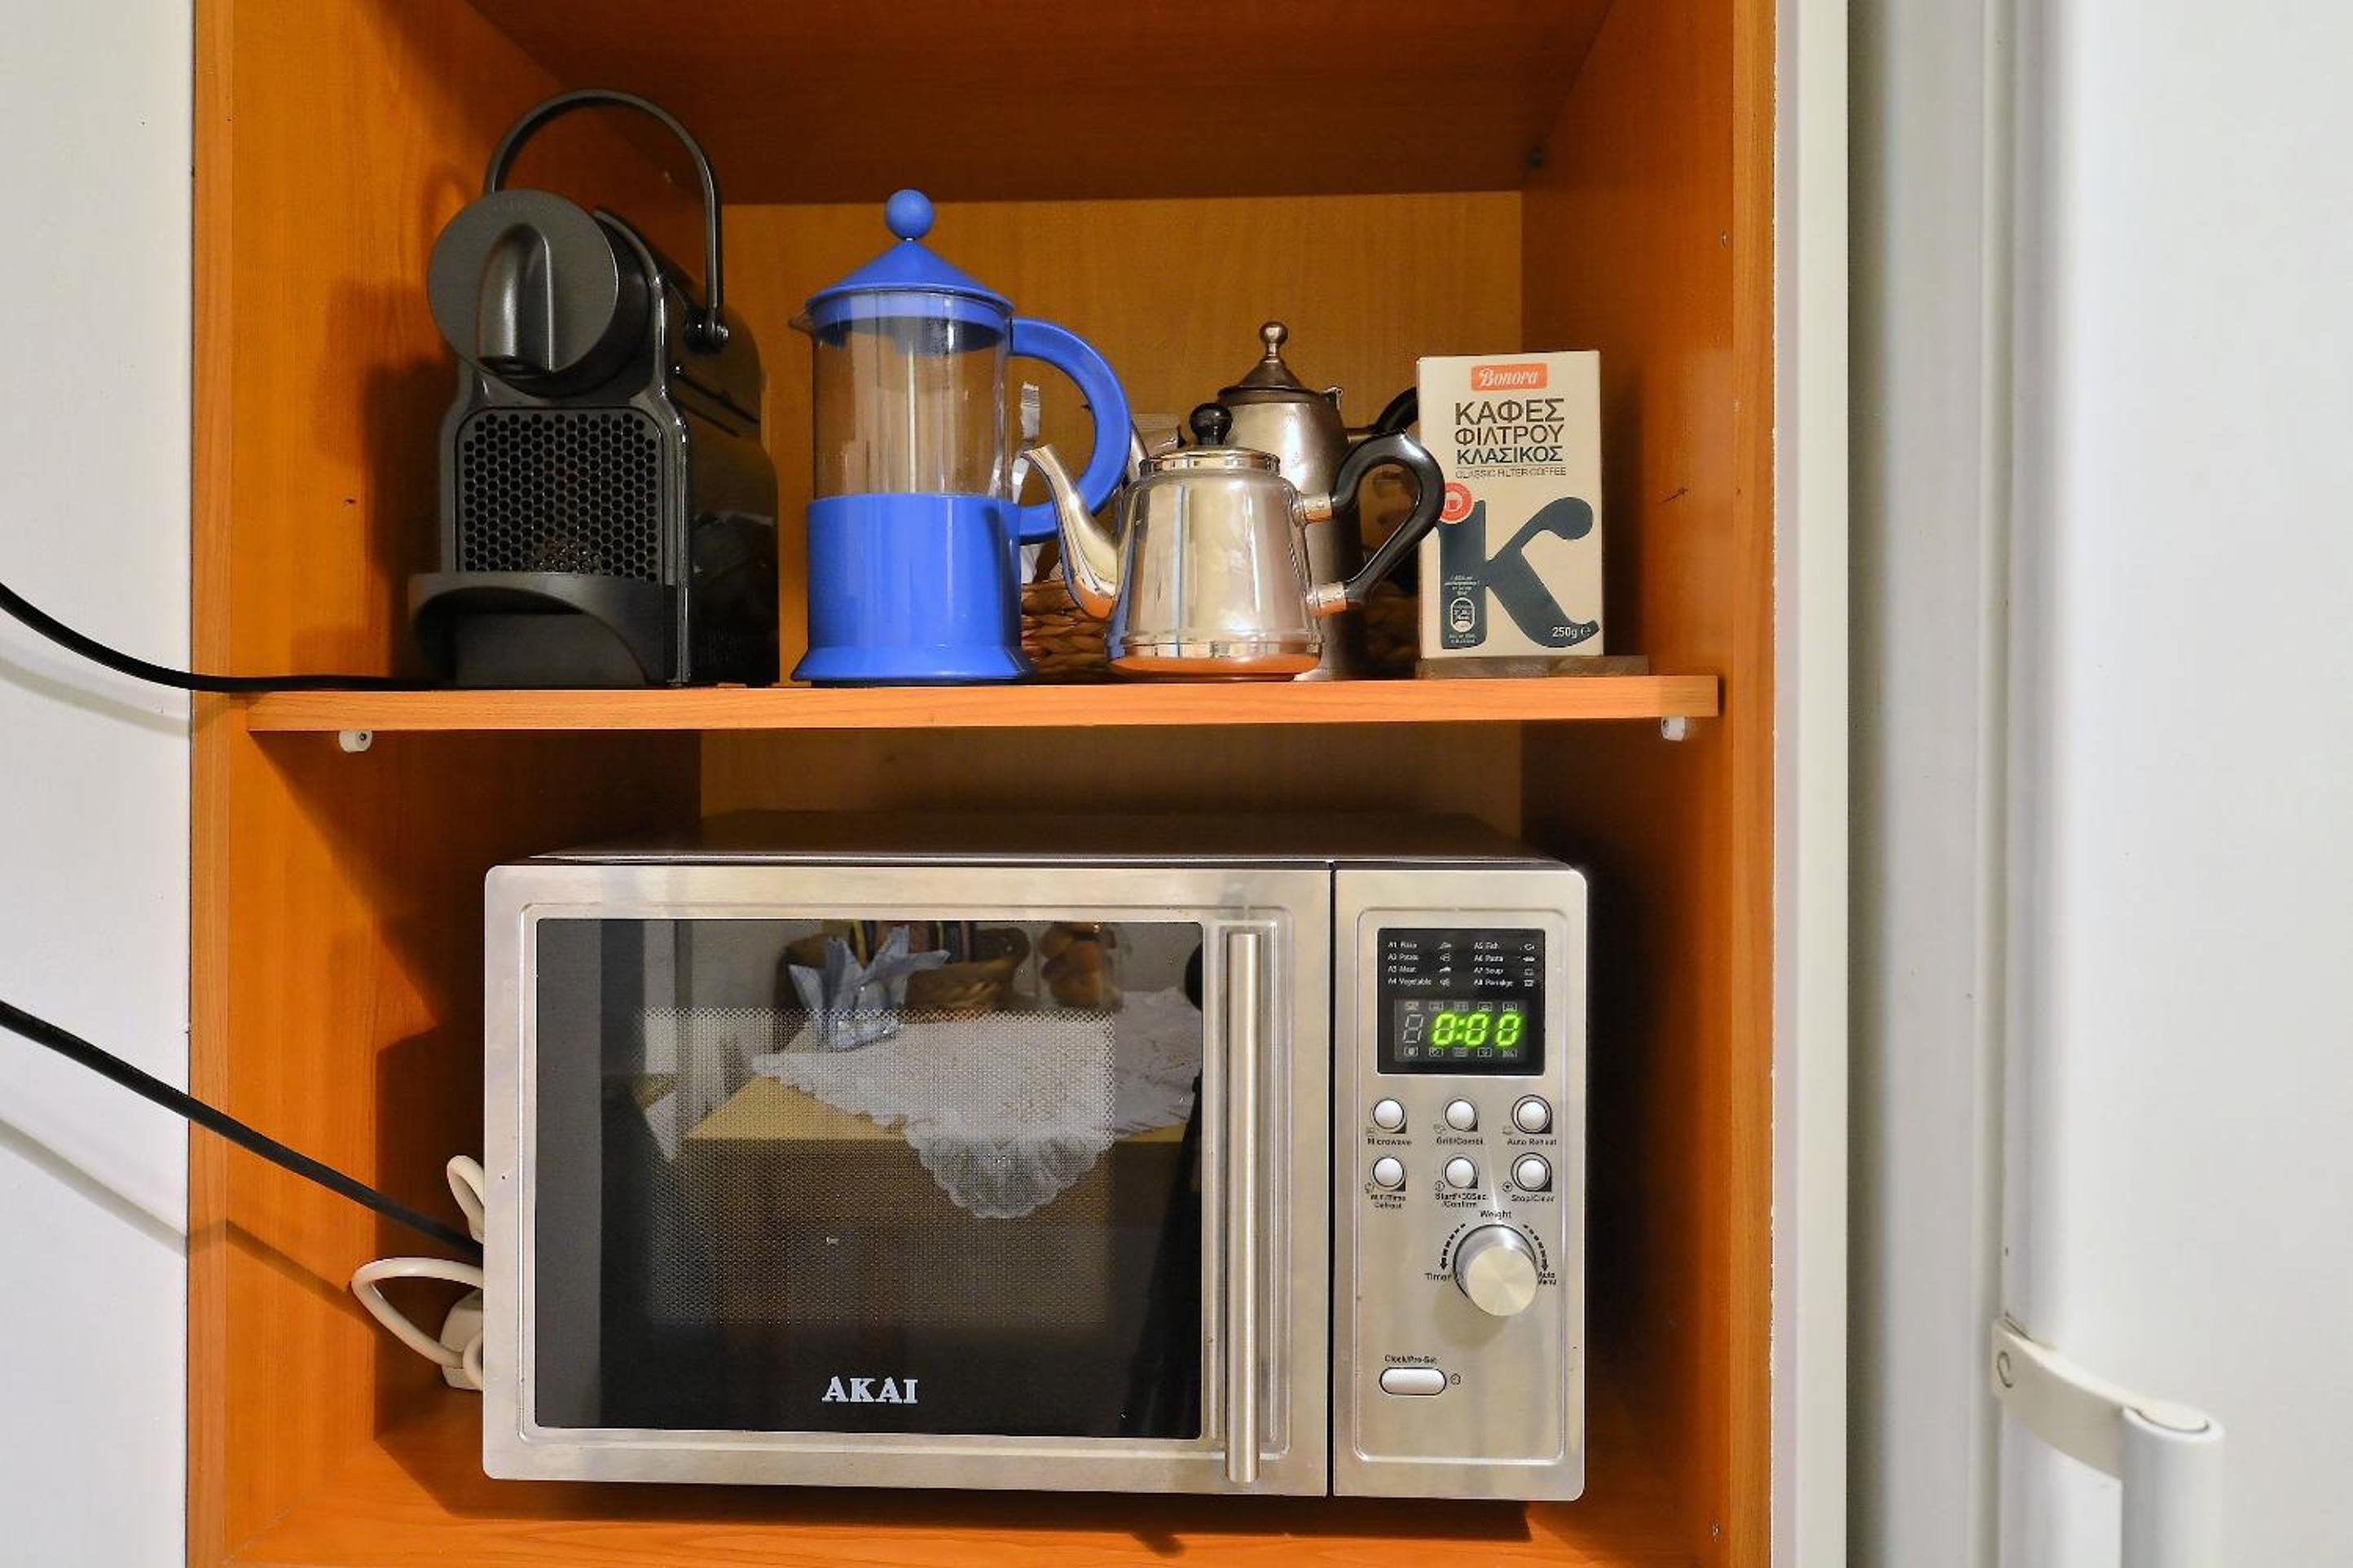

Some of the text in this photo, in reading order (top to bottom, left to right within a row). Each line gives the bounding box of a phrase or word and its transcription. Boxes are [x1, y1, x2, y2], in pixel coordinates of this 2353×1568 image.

[1479, 367, 1539, 387] Bonora
[1454, 397, 1565, 426] ΚΑΦΕΣ
[1454, 424, 1565, 446] ΦΙΛΤΡΟΥ
[1456, 446, 1564, 465] ΚΛΑΣΙΚΟΣ
[1455, 466, 1567, 479] CLASSIC FILTER COFFEE
[1551, 626, 1577, 639] 250g
[1432, 1013, 1522, 1047] 0:00
[1480, 1210, 1513, 1220] Weight
[820, 1374, 919, 1404] AKAI
